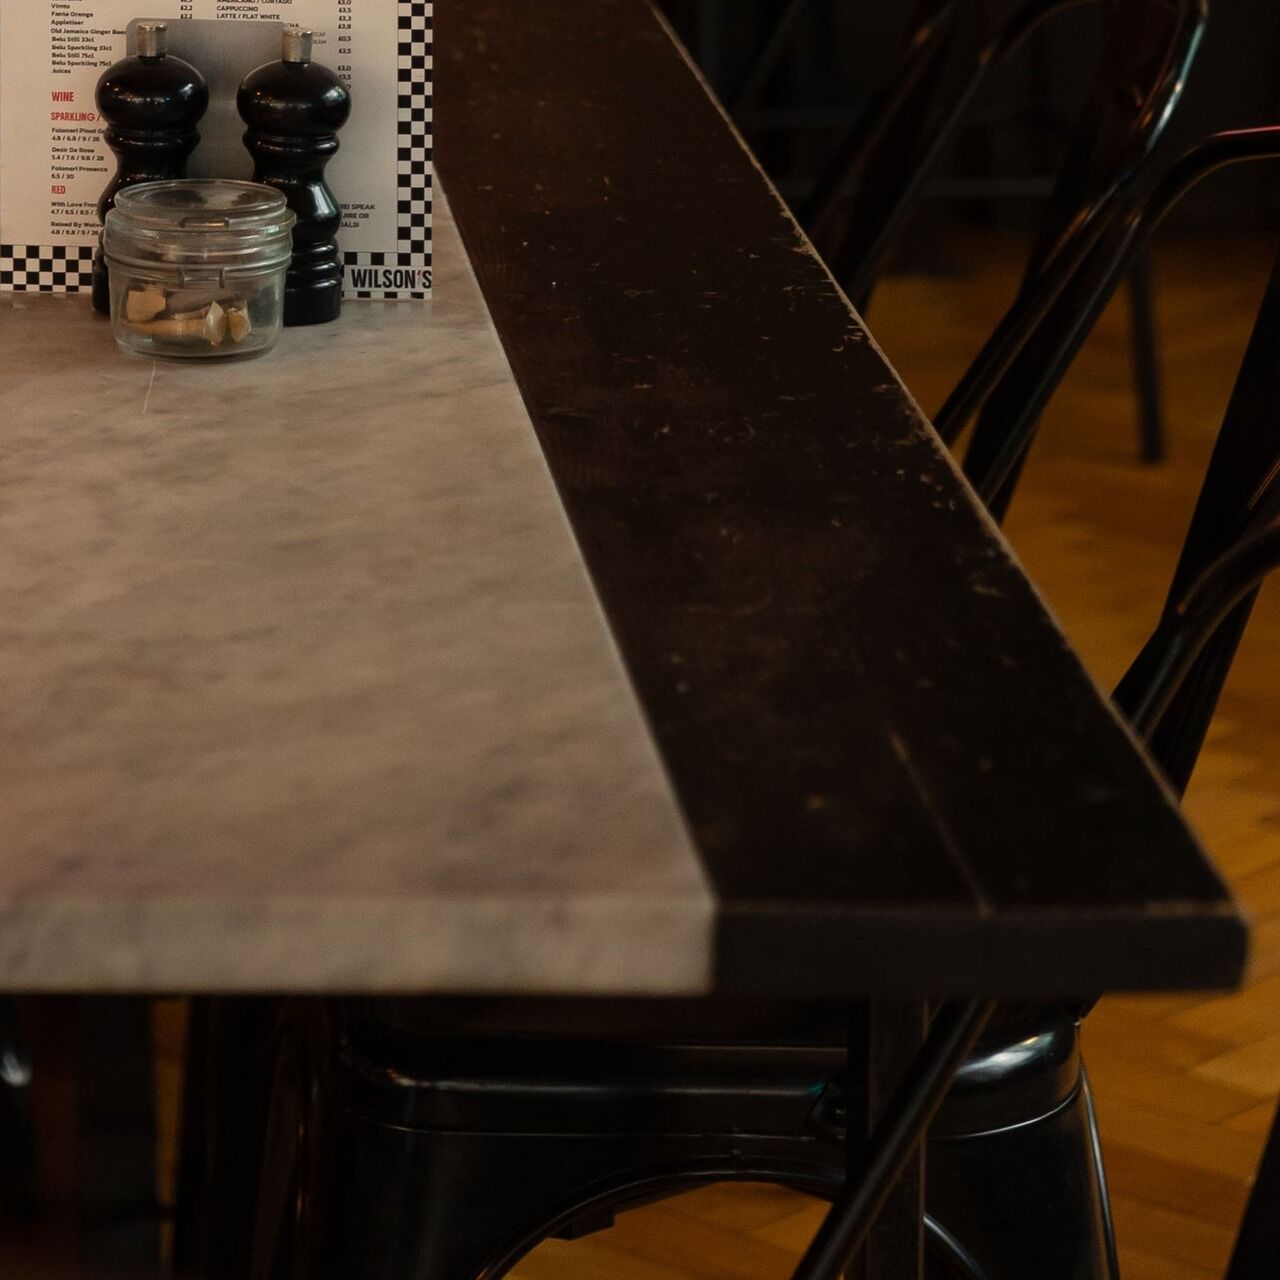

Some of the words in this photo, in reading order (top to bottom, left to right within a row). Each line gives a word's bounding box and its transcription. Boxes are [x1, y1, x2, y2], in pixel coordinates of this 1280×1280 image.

[52, 92, 74, 102] WINE
[51, 112, 95, 121] SPARKLING
[52, 185, 66, 194] RED
[352, 269, 432, 288] WILSON'S
